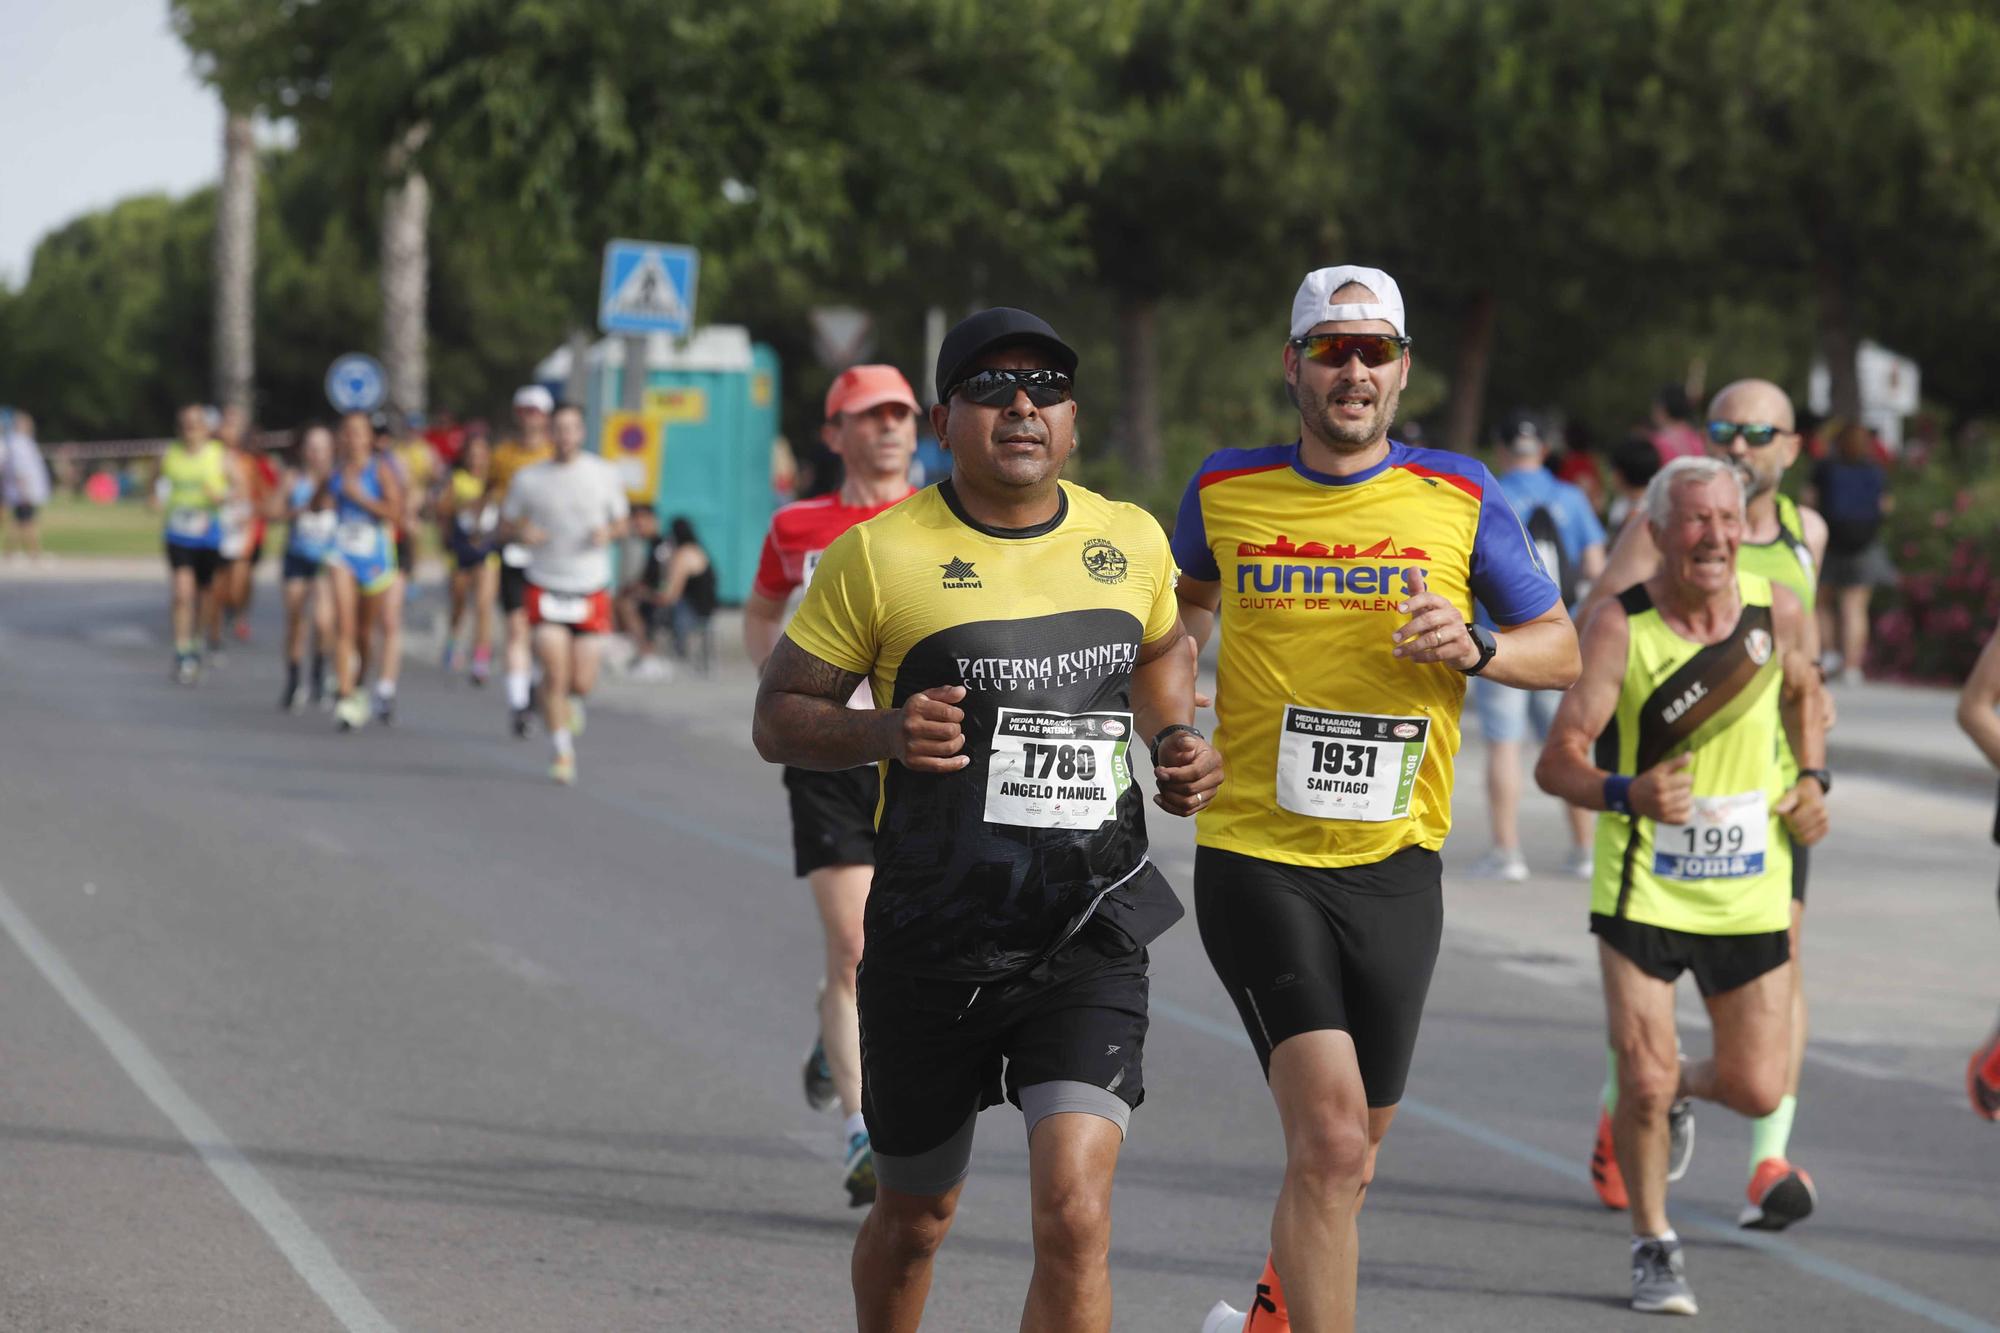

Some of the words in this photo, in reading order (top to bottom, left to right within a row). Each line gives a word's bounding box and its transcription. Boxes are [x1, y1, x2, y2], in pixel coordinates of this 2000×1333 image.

[943, 580, 982, 589] luanvi
[1239, 598, 1295, 609] CIUTAT
[1304, 598, 1330, 610] DE
[1339, 596, 1399, 612] VALÈN
[957, 658, 1051, 679] PATERNA
[1057, 642, 1138, 675] RUNNERS
[1008, 724, 1027, 732] VILA
[1029, 725, 1040, 733] DE
[1041, 726, 1075, 735] PATERNA
[1010, 717, 1034, 725] MEDIA
[1294, 721, 1313, 731] VILA
[1315, 724, 1325, 732] DE
[1326, 725, 1362, 736] PATERNA
[1295, 713, 1319, 724] MEDIA
[1321, 717, 1361, 728] MARATÓN
[1023, 743, 1096, 781] 1780
[1114, 755, 1124, 779] BOX
[1312, 740, 1378, 778] 1931
[1405, 754, 1418, 777] BOX
[1000, 781, 1053, 799] ANGELO
[1056, 786, 1107, 801] MANUEL
[1307, 777, 1369, 795] SANTIAGO
[1682, 825, 1744, 855] 199
